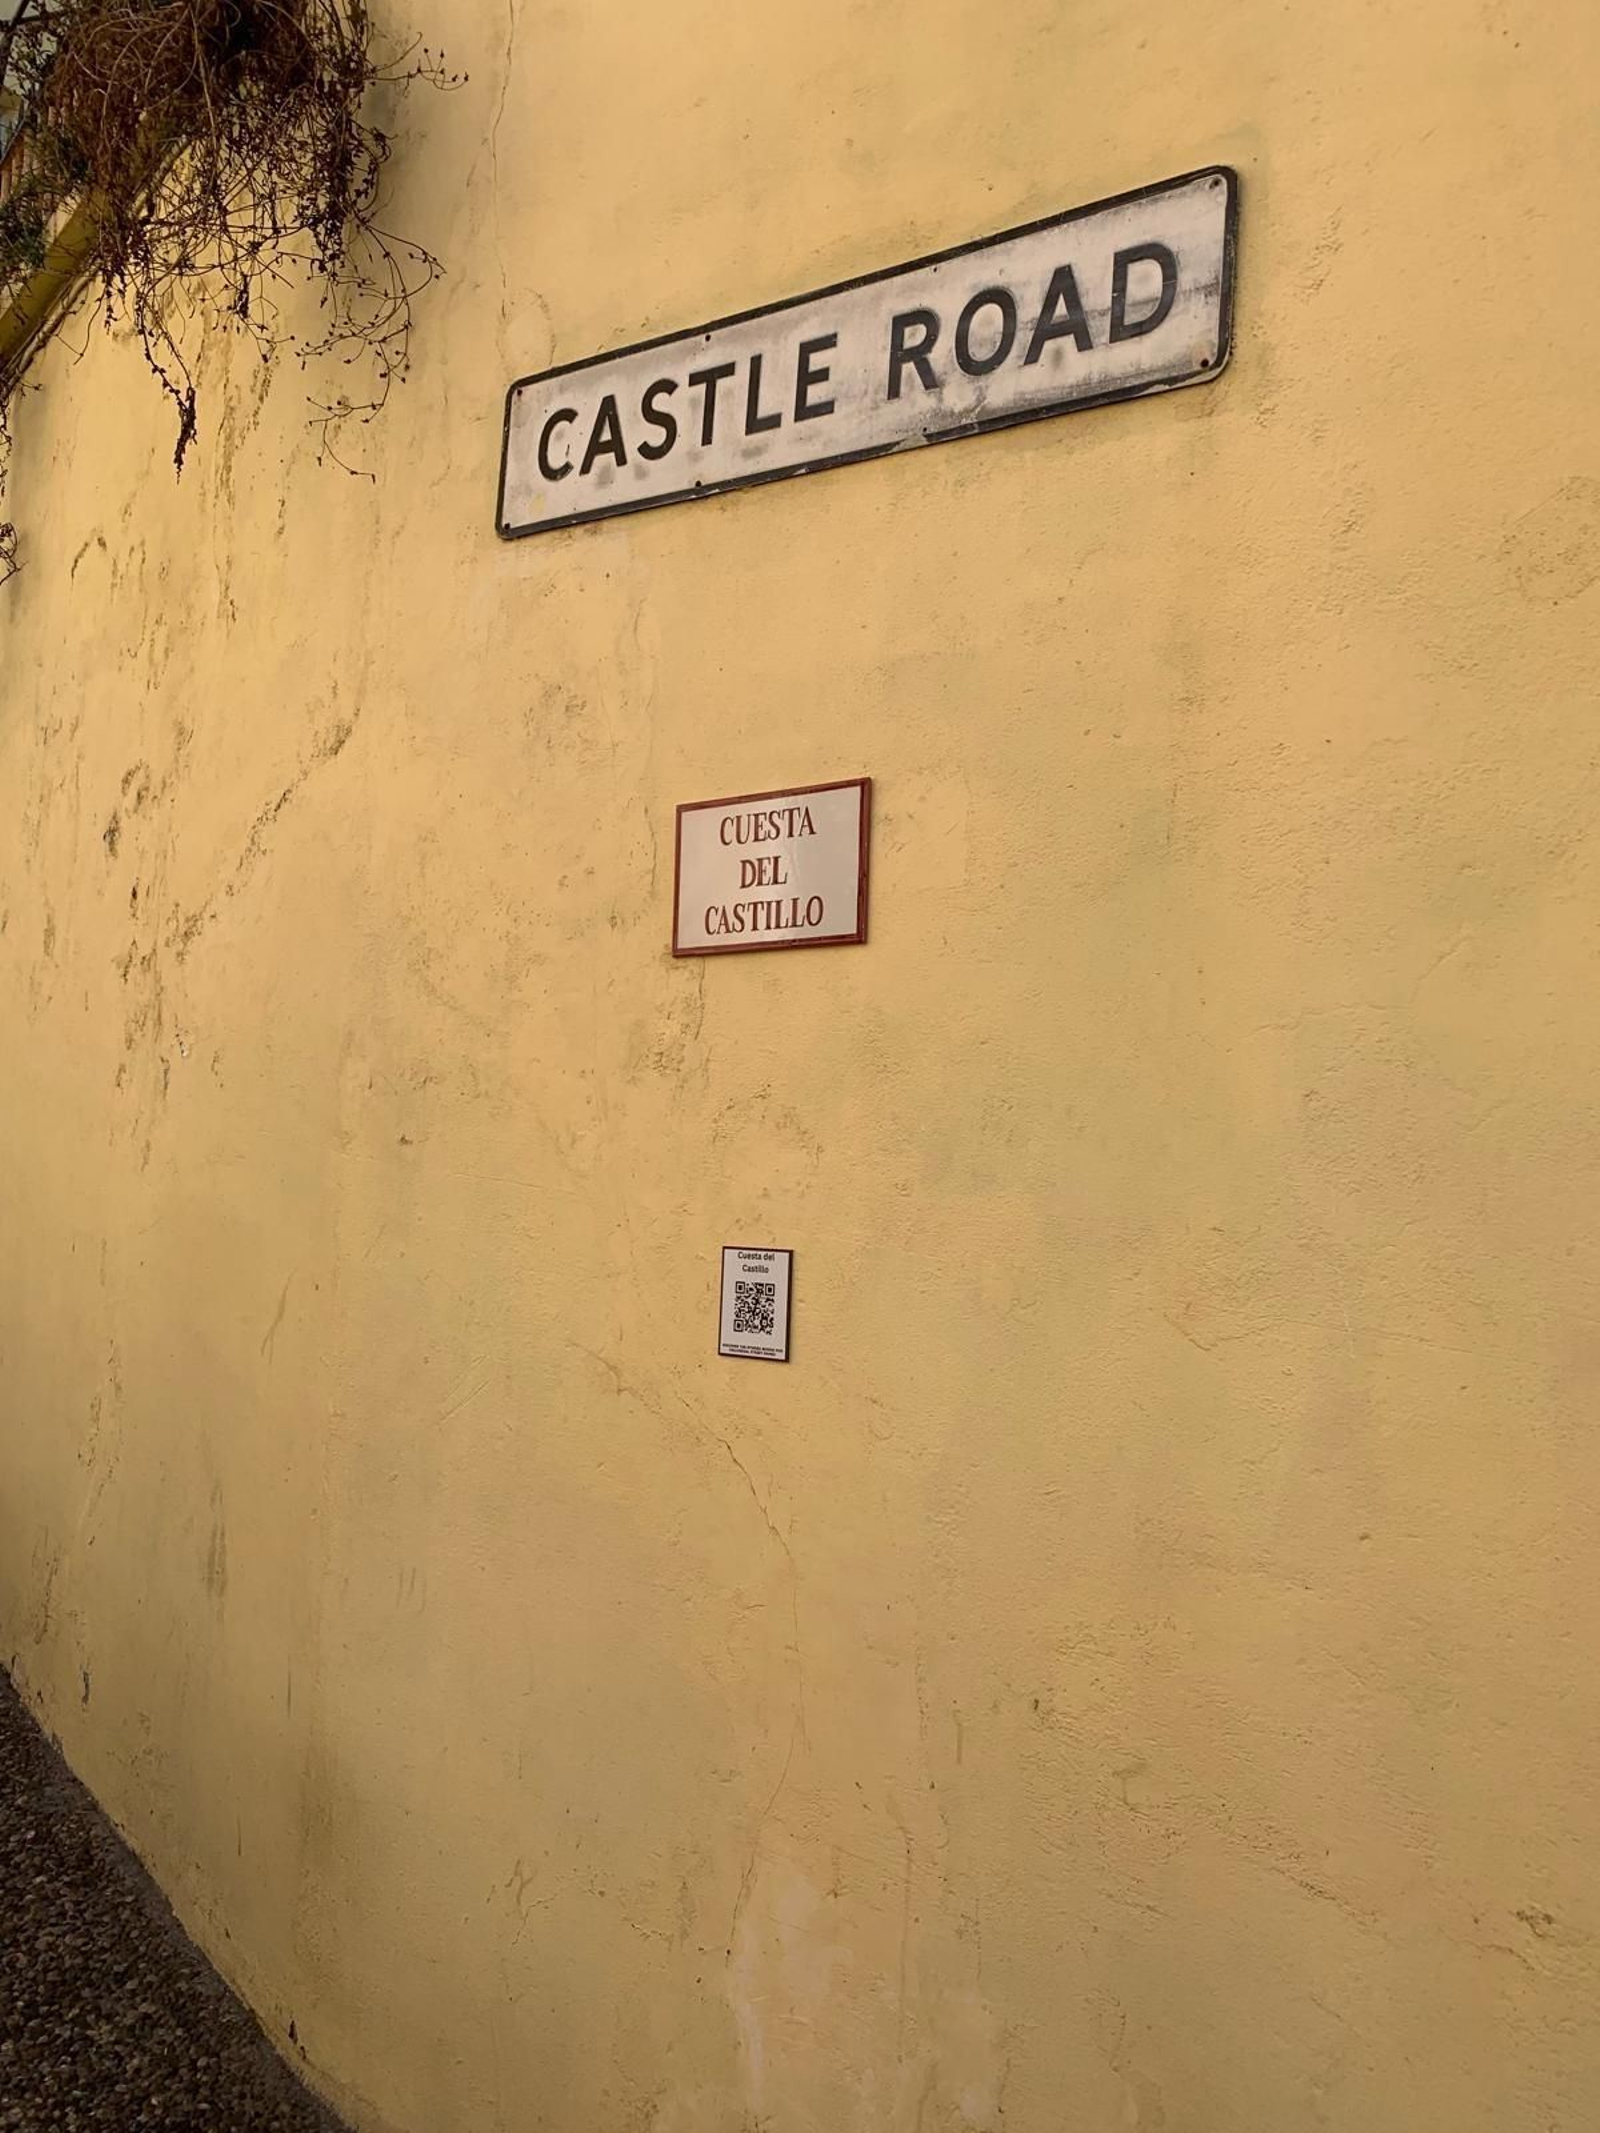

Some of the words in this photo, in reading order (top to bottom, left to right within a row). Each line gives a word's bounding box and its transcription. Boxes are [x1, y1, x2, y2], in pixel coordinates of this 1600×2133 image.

[536, 333, 838, 482] CASTLE
[887, 242, 1179, 400] ROAD
[719, 806, 816, 846] CUESTA
[739, 855, 788, 889] DEL
[704, 896, 824, 935] CASTILLO
[737, 1251, 762, 1260] Cuesta
[763, 1252, 776, 1261] del
[742, 1264, 769, 1273] Castillo
